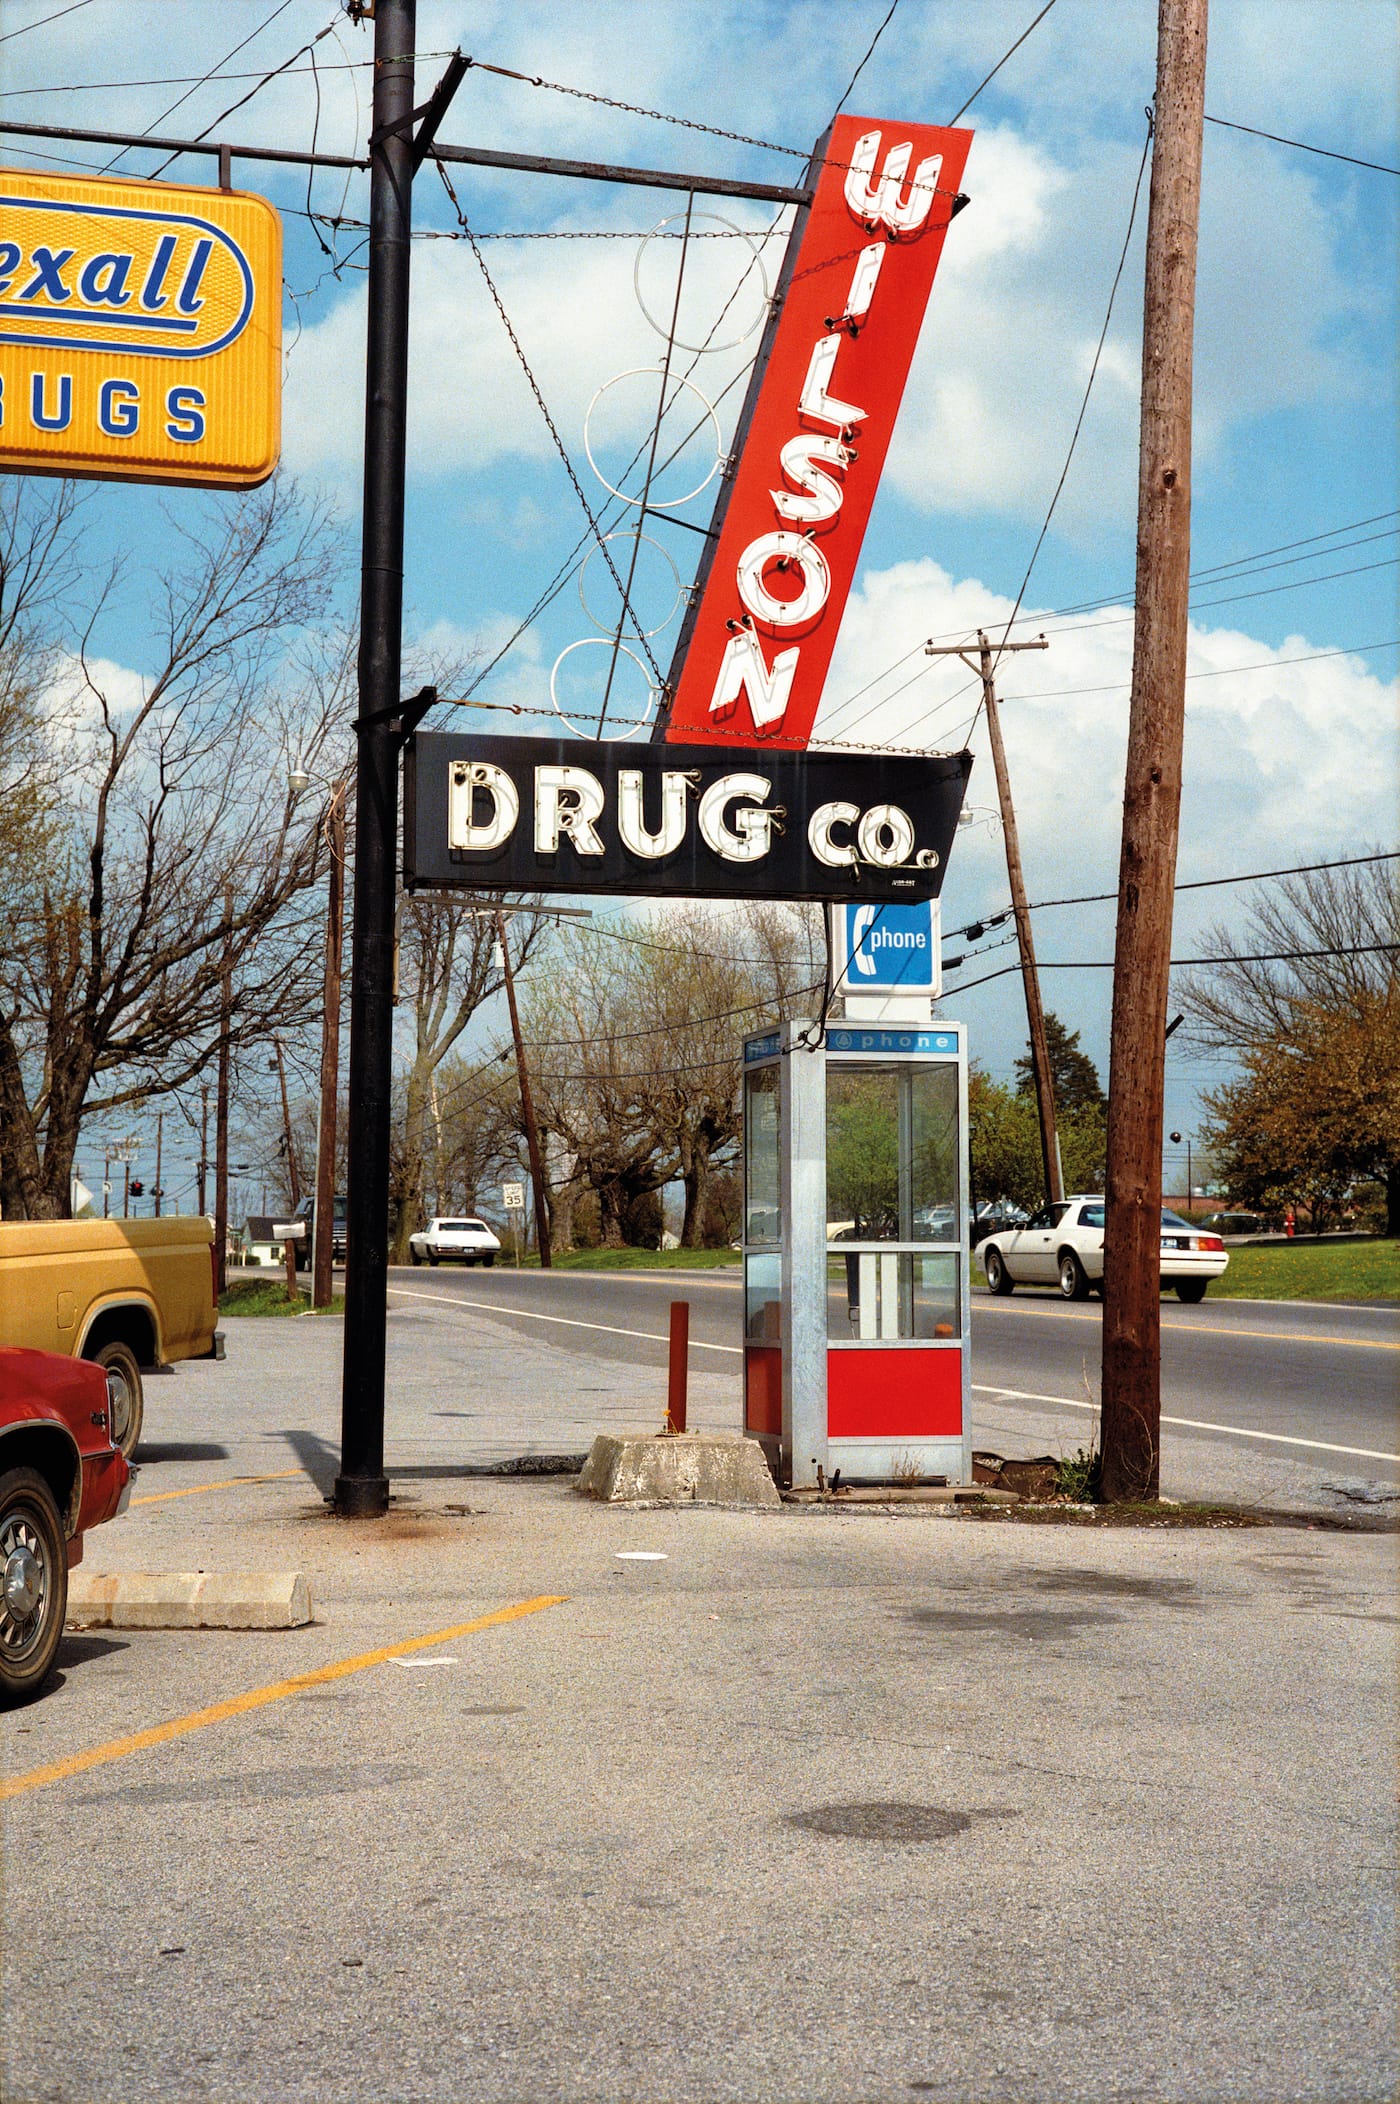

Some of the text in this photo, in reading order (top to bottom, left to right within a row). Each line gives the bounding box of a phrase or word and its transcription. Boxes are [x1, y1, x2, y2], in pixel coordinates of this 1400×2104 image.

[0, 373, 205, 443] UGS
[709, 129, 943, 728] WILSON
[448, 760, 773, 863] DRUG
[870, 926, 926, 953] phone
[861, 1033, 949, 1048] phone
[506, 1195, 521, 1205] 35
